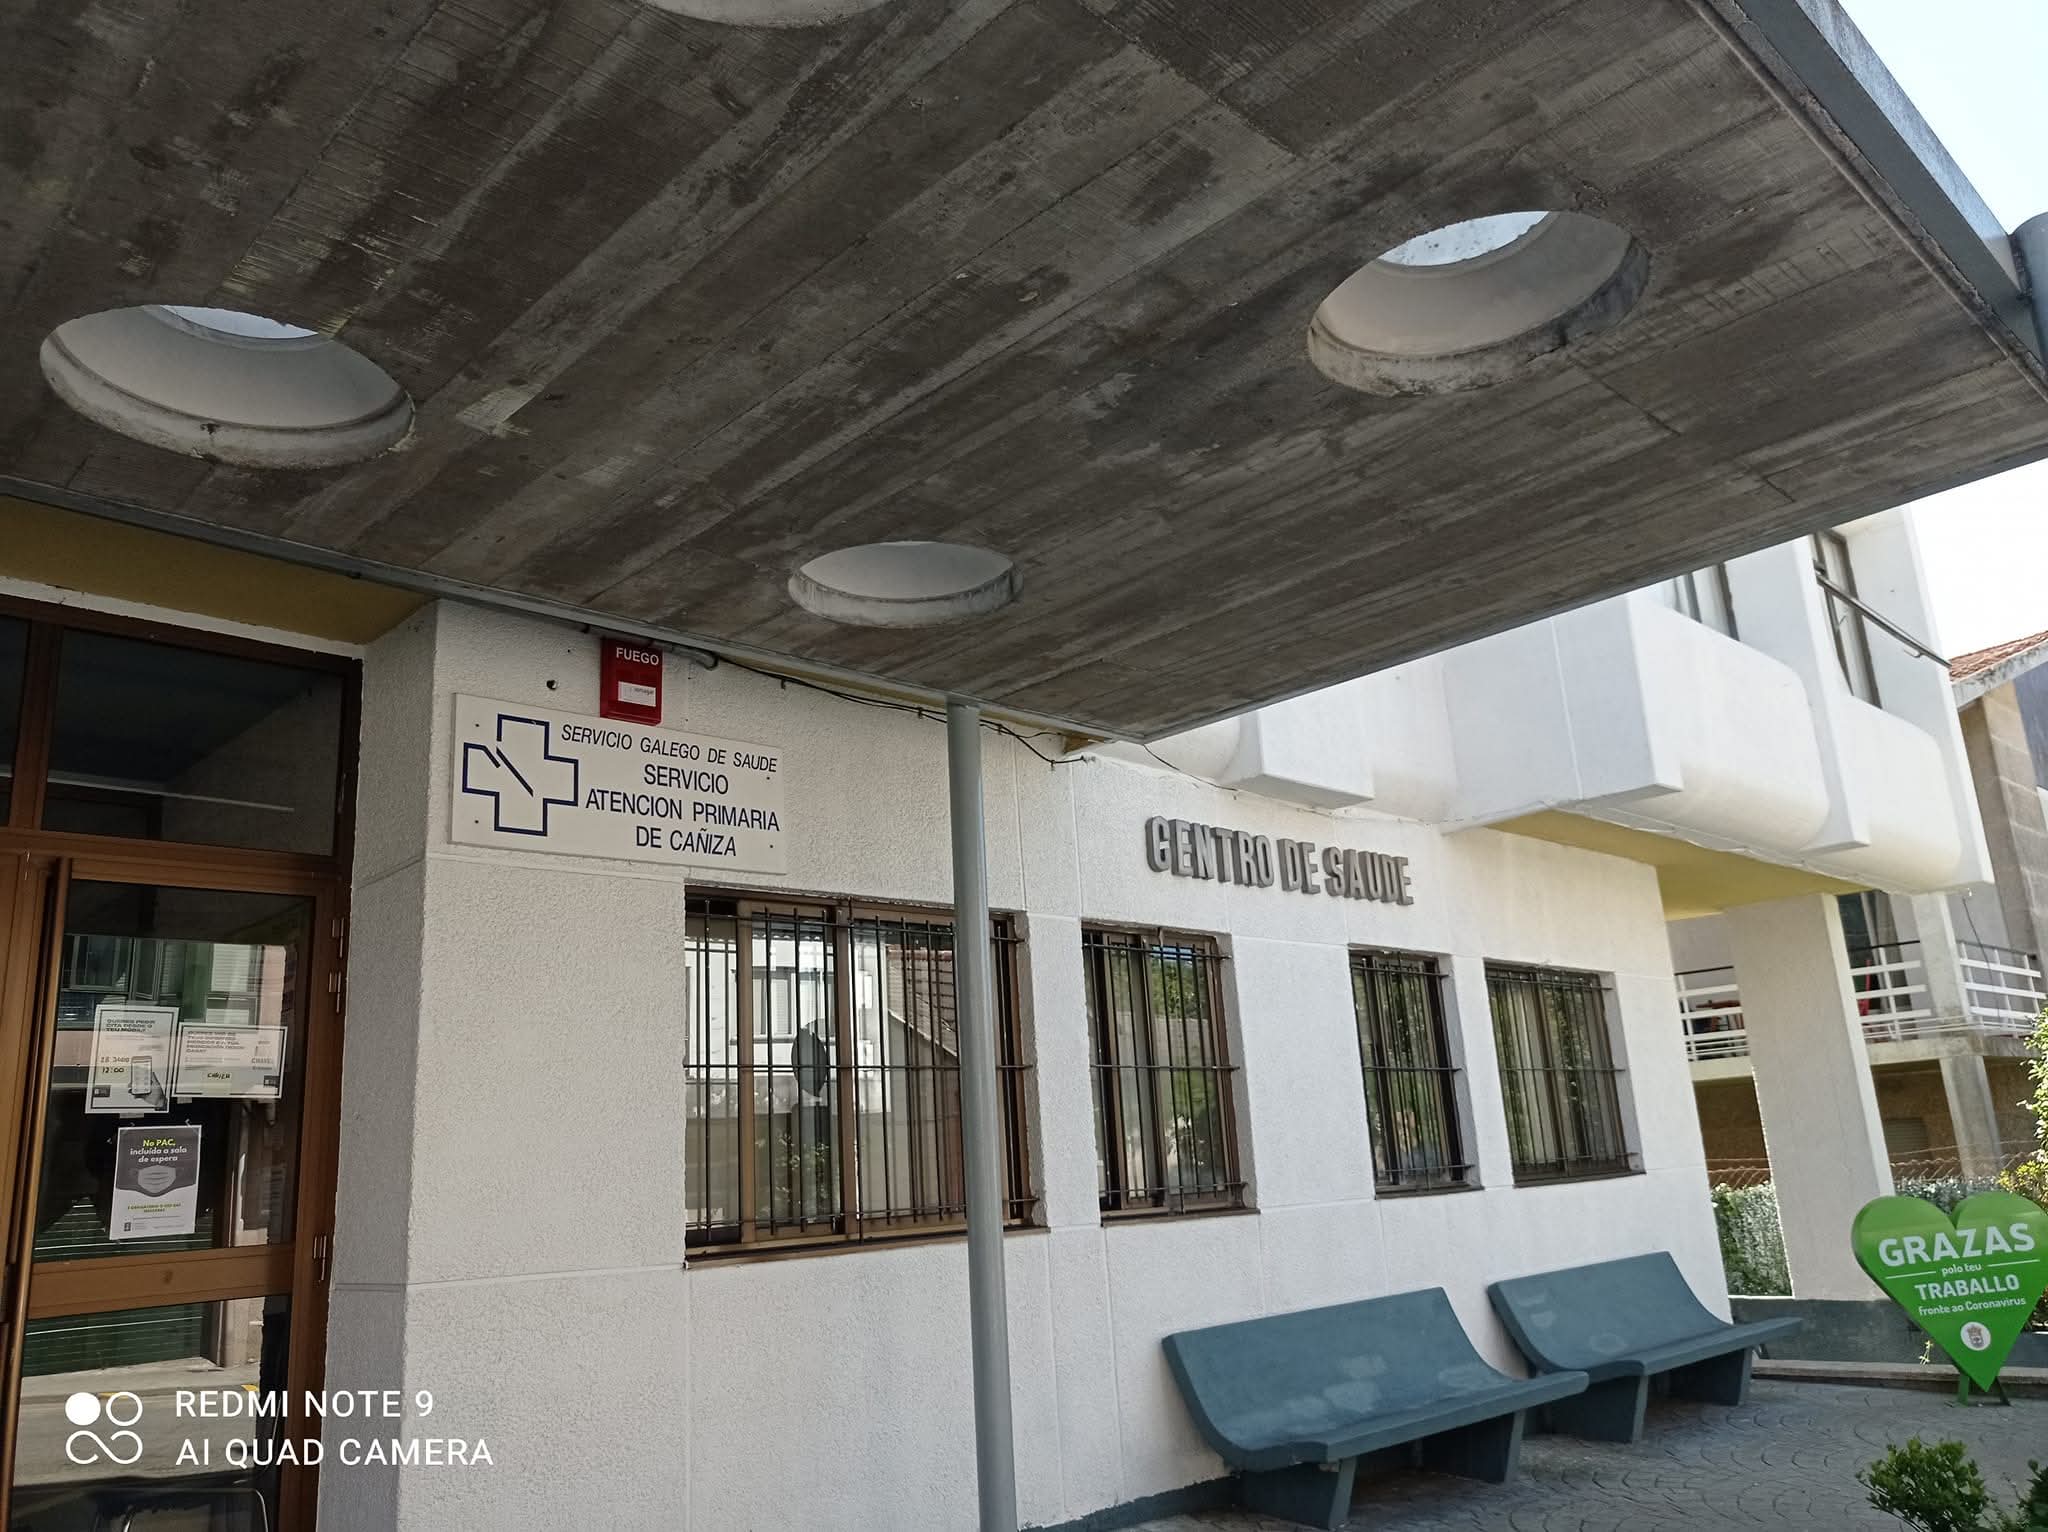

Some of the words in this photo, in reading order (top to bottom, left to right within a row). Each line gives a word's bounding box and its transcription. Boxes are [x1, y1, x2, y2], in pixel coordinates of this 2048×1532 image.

[616, 647, 660, 666] FUEGO
[561, 724, 633, 751] SERVICIO
[640, 736, 701, 762] GALEGO
[707, 748, 728, 766] DE
[733, 752, 778, 774] SAUDE
[643, 763, 730, 796] SERVICIO
[585, 788, 683, 821] ATENCION
[692, 802, 780, 832] PRIMARIA
[635, 826, 663, 849] DE
[670, 827, 737, 857] CAÑIZA
[1145, 815, 1275, 889] CENTRO
[1276, 838, 1321, 895] DE
[1321, 846, 1415, 906] SAUDE
[142, 1139, 155, 1147] No
[170, 1146, 188, 1154] sala
[138, 1155, 149, 1163] de
[150, 1155, 178, 1164] espera
[1878, 1222, 2036, 1267] GRAZAS
[1964, 1262, 1982, 1273] teu
[1914, 1274, 2020, 1301] TRABALLO
[1951, 1303, 1964, 1312] ao
